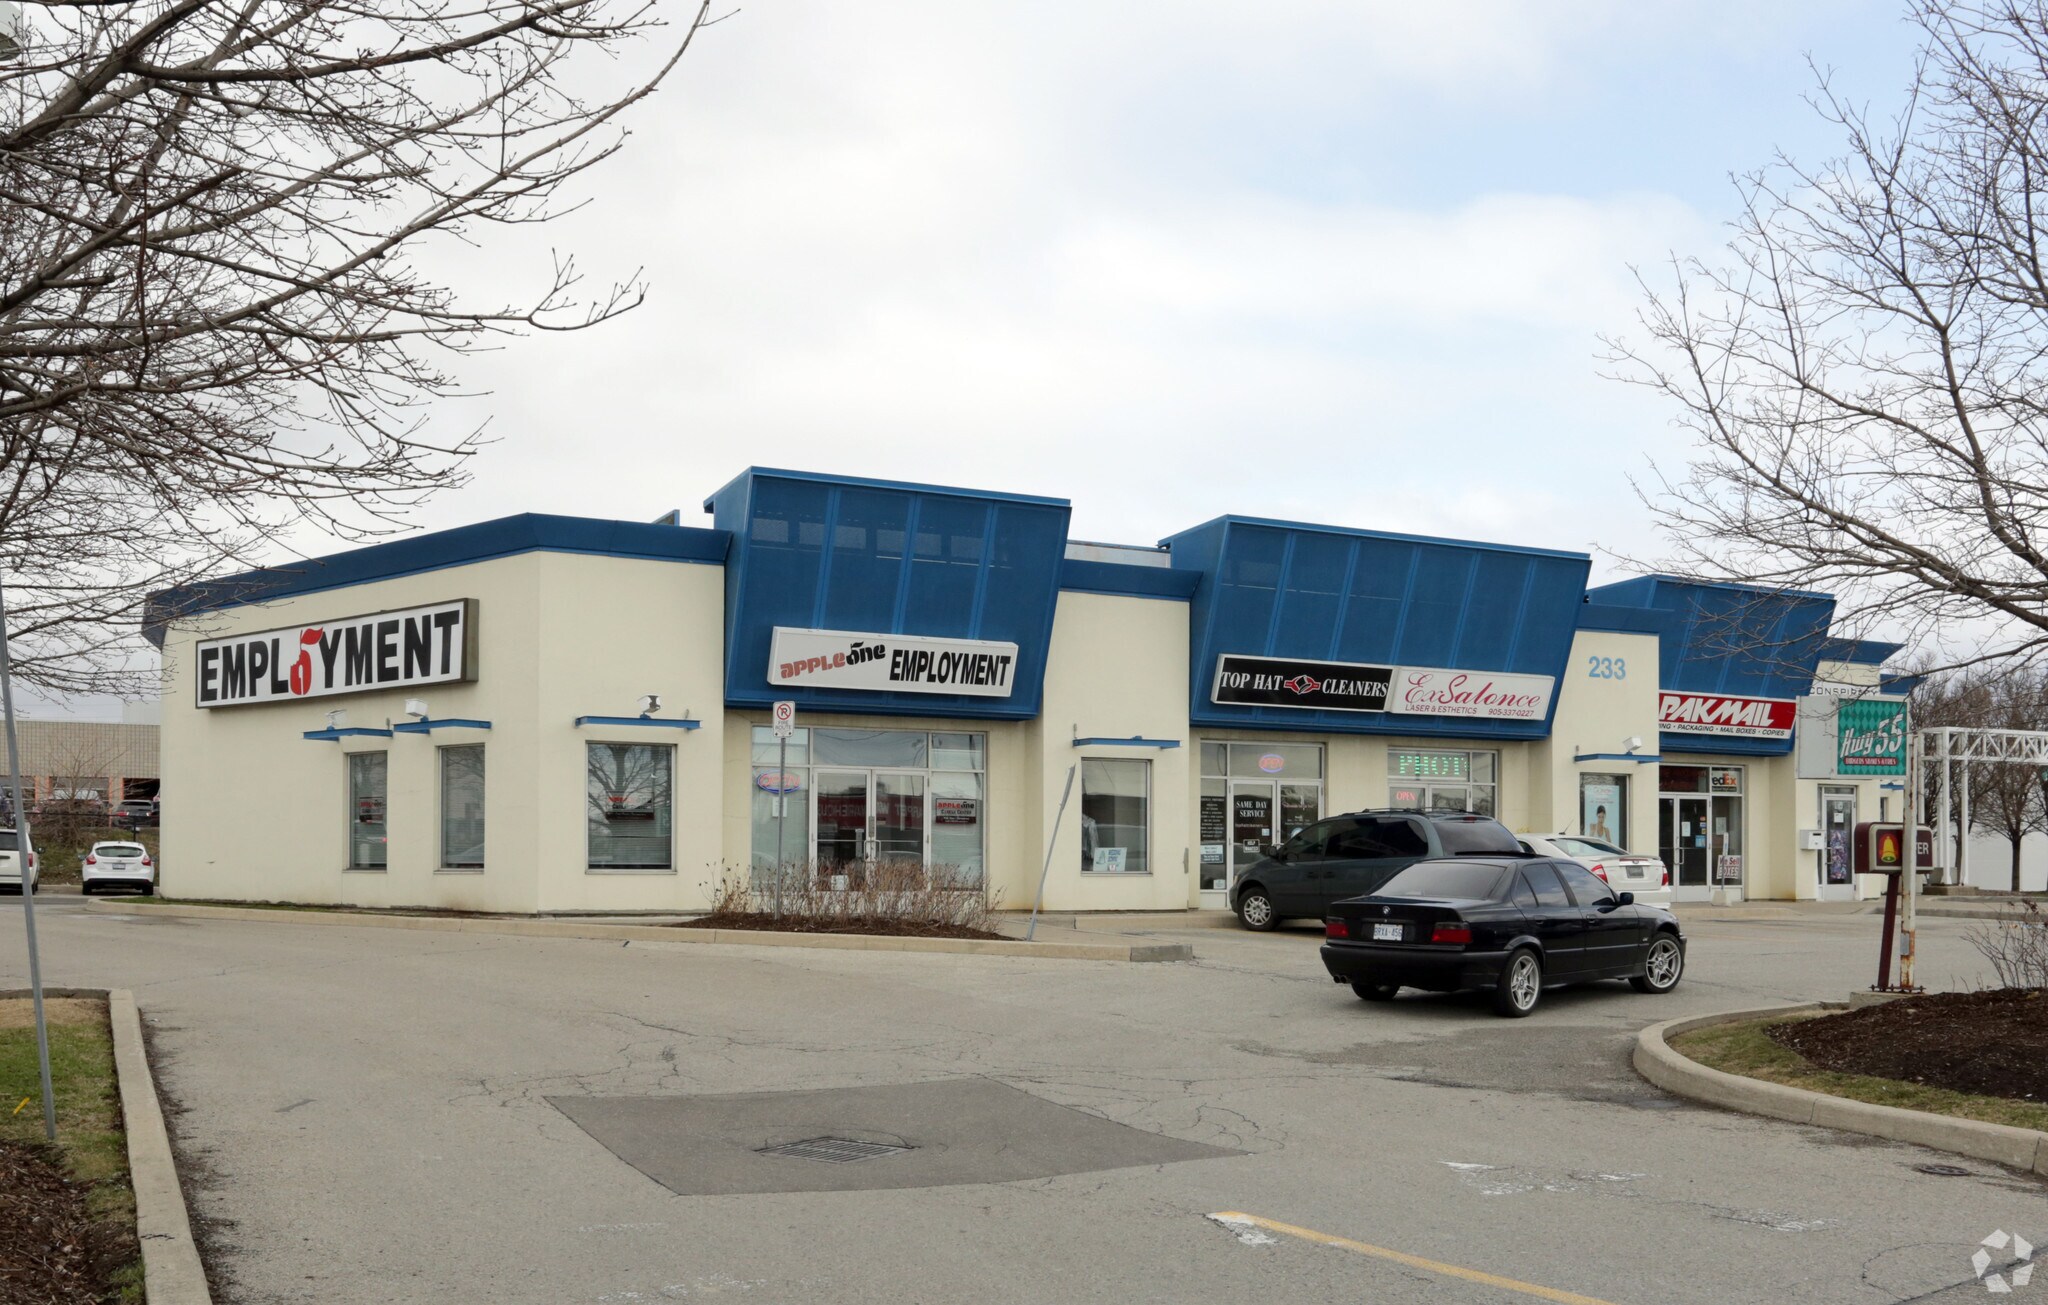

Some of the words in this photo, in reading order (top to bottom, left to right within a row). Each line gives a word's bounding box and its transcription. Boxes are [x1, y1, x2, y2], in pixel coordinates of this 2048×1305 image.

[889, 649, 1012, 687] EMPLOYMENT
[1588, 655, 1626, 680] 233
[1221, 671, 1250, 688] TOP
[1253, 674, 1284, 691] HAT
[1322, 678, 1389, 698] CLEANERS
[1809, 686, 1879, 696] CONSPIRY
[1405, 704, 1429, 712] LASER
[1431, 705, 1436, 713] &
[1437, 705, 1477, 715] ESTHETICS
[1488, 709, 1534, 717] 905-337-0227
[1677, 724, 1714, 732] PACKAGING
[1711, 771, 1737, 786] edEx
[1396, 791, 1416, 801] OPEN
[1236, 800, 1254, 809] SAME
[1255, 801, 1268, 809] DAY
[1239, 809, 1266, 818] SERVICE
[1916, 842, 1929, 855] ER
